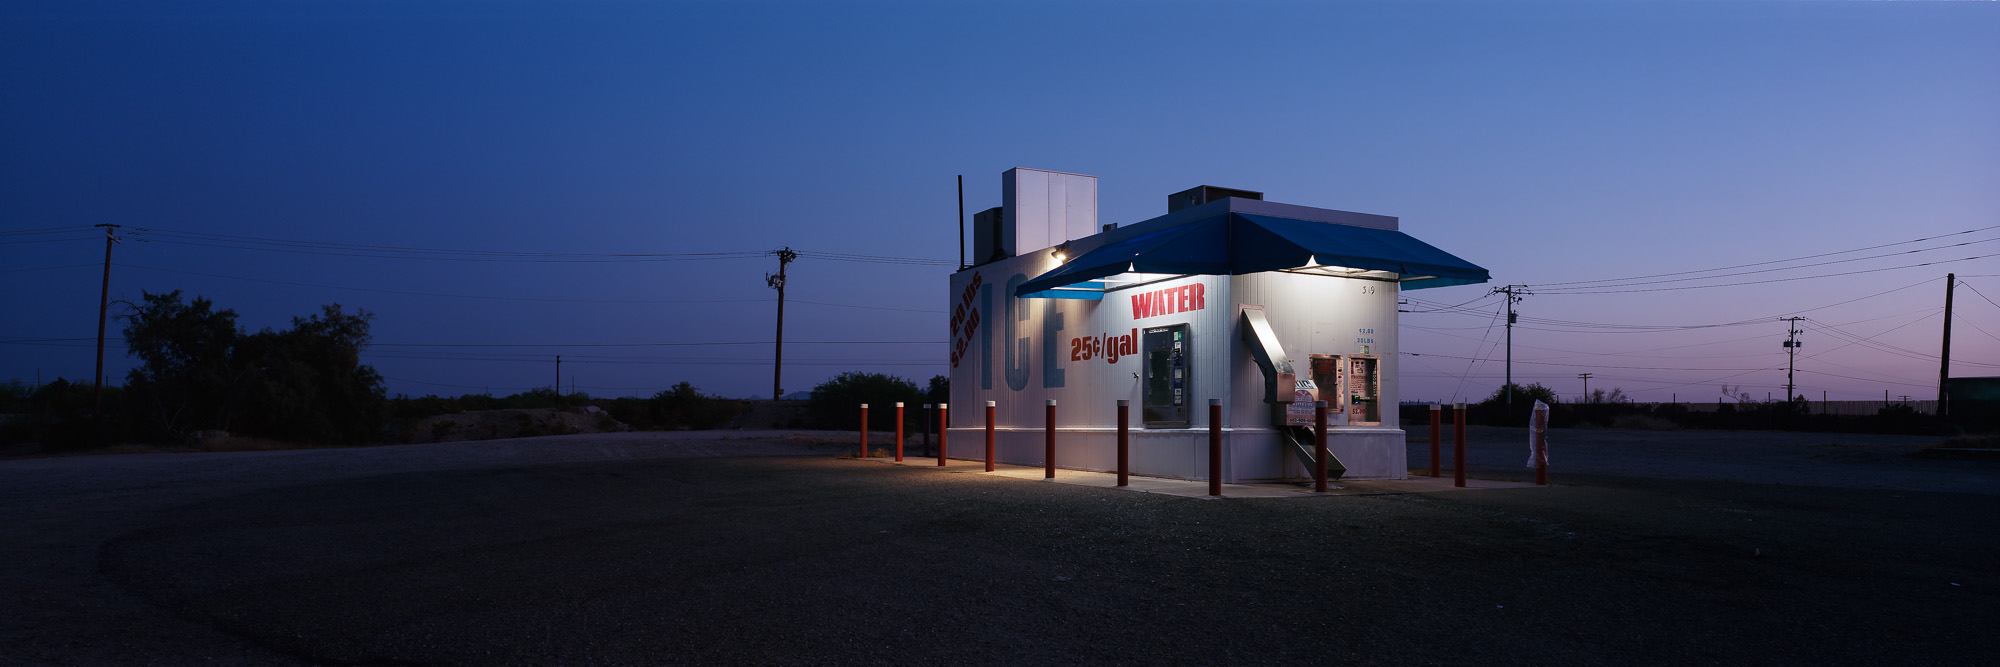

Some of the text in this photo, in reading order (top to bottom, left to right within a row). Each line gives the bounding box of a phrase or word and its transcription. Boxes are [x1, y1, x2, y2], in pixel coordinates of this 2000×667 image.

[951, 303, 965, 337] 20
[1131, 283, 1204, 322] WATER
[952, 307, 980, 368] $2.00
[981, 273, 1065, 391] ICE
[1071, 328, 1138, 364] 25¢/gal
